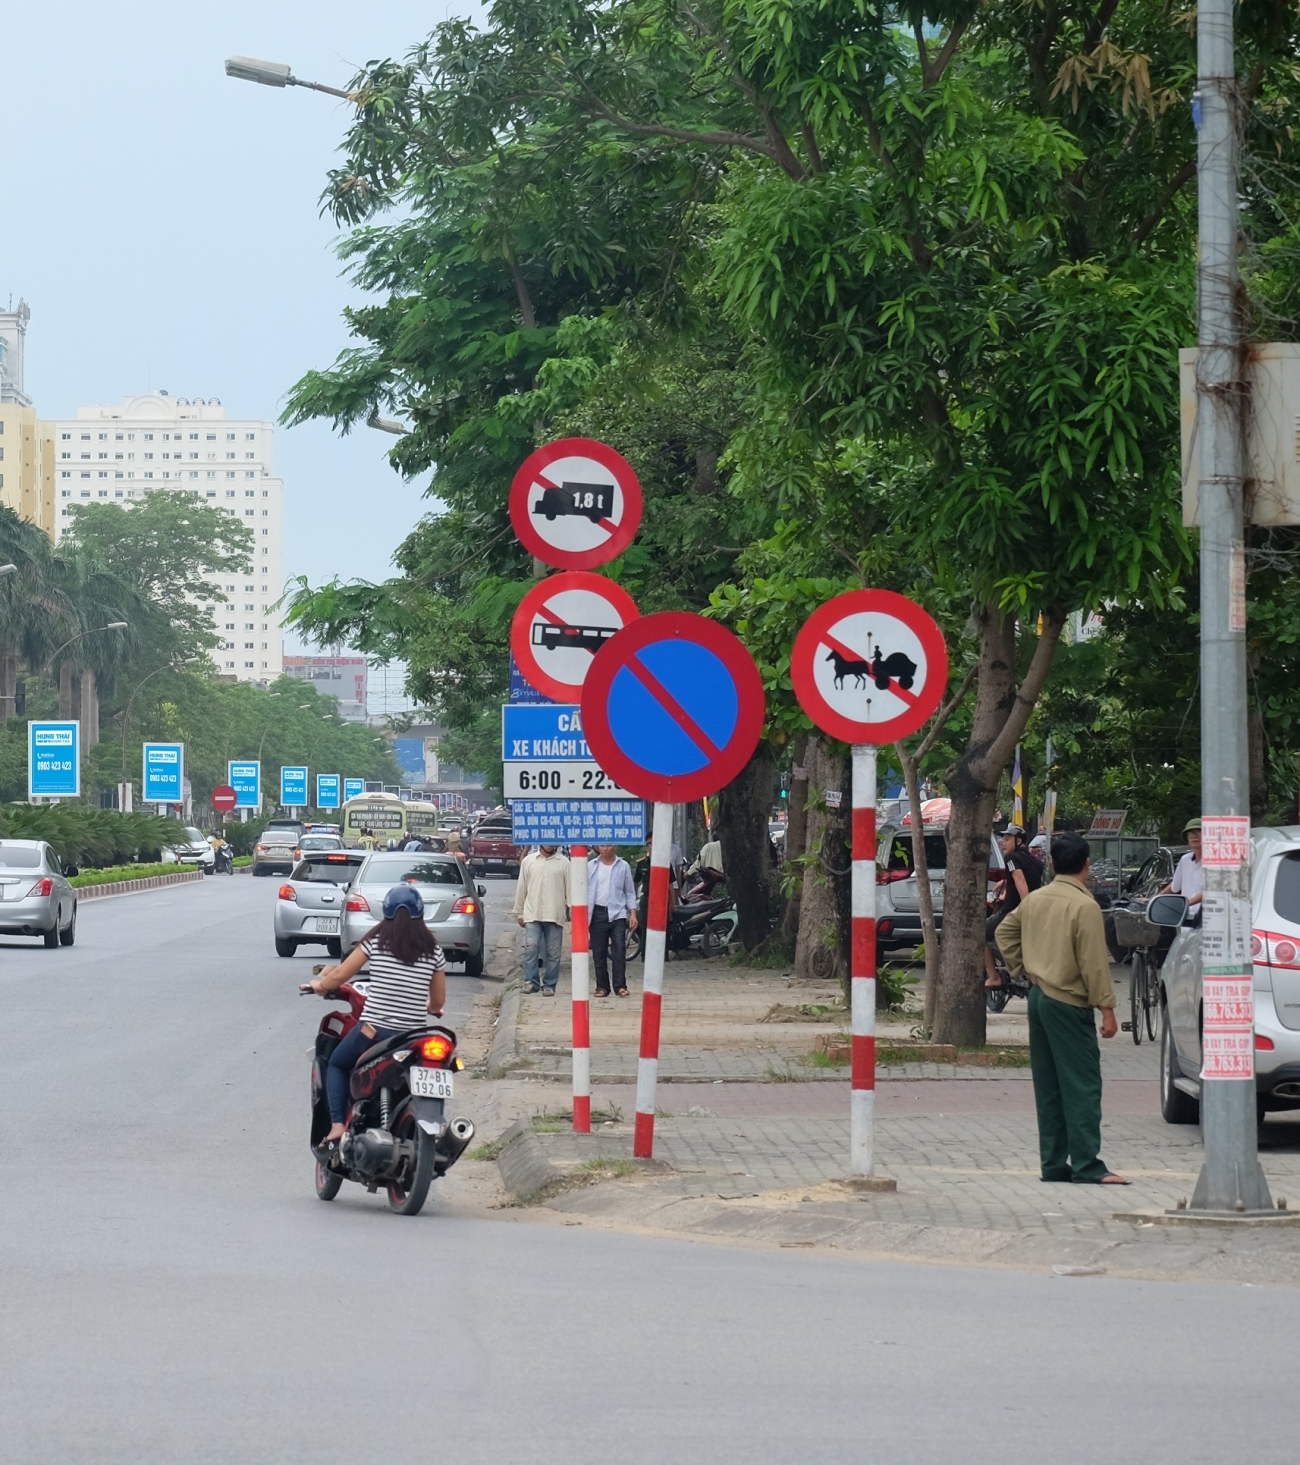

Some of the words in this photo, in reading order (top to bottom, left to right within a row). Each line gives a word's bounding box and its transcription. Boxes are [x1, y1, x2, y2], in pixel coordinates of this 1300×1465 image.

[573, 492, 594, 508] 1,8
[597, 494, 603, 508] t
[513, 740, 529, 756] XE
[533, 736, 576, 756] KHÁCH
[520, 771, 561, 789] 6:00
[416, 1082, 451, 1096] 192.06
